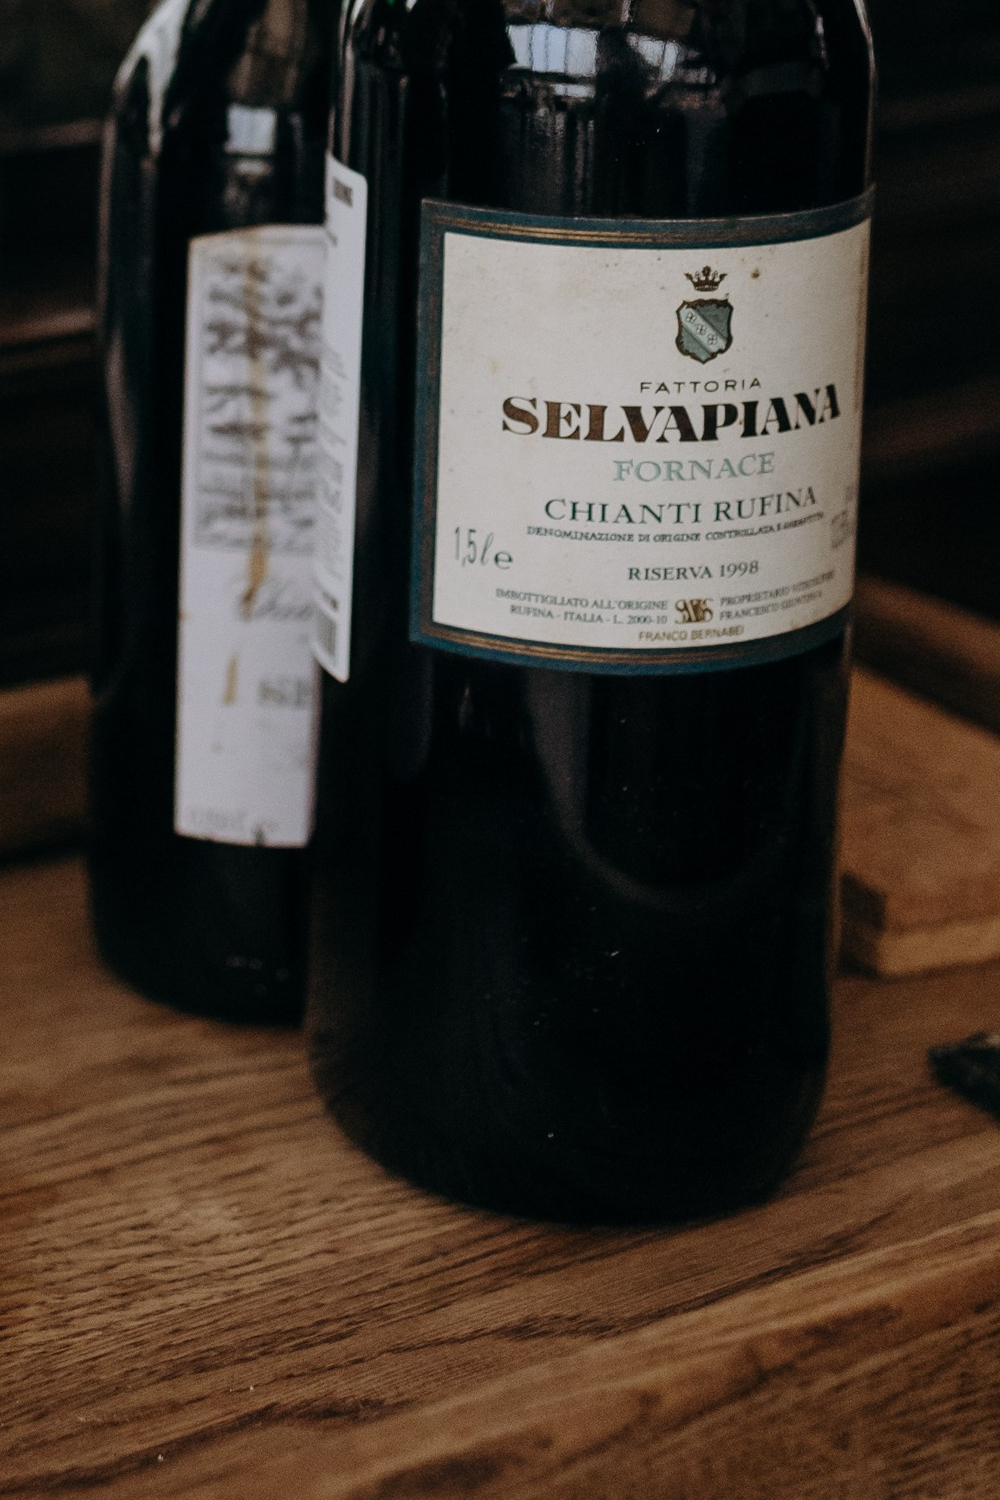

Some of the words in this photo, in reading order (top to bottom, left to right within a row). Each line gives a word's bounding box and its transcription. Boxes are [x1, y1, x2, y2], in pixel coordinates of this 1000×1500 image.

[639, 377, 762, 395] FATTORIA
[501, 383, 842, 443] SELVAPIANA
[613, 452, 776, 482] FORNACE
[544, 497, 703, 525] CHIANTI
[713, 486, 817, 523] RUFINA
[526, 525, 634, 542] DENOMINAZIONE
[638, 532, 650, 542] DI
[653, 532, 701, 543] ORIGINE
[705, 526, 775, 541] CONTROLLATA
[627, 566, 713, 581] RISERVA
[719, 560, 759, 579] 1998
[495, 587, 588, 607] IMBOTTIGLIATO
[510, 604, 554, 619] RUFINA
[563, 611, 602, 623] ITALIA
[720, 603, 779, 620] FRANCESCO
[638, 630, 688, 642] FRANCO
